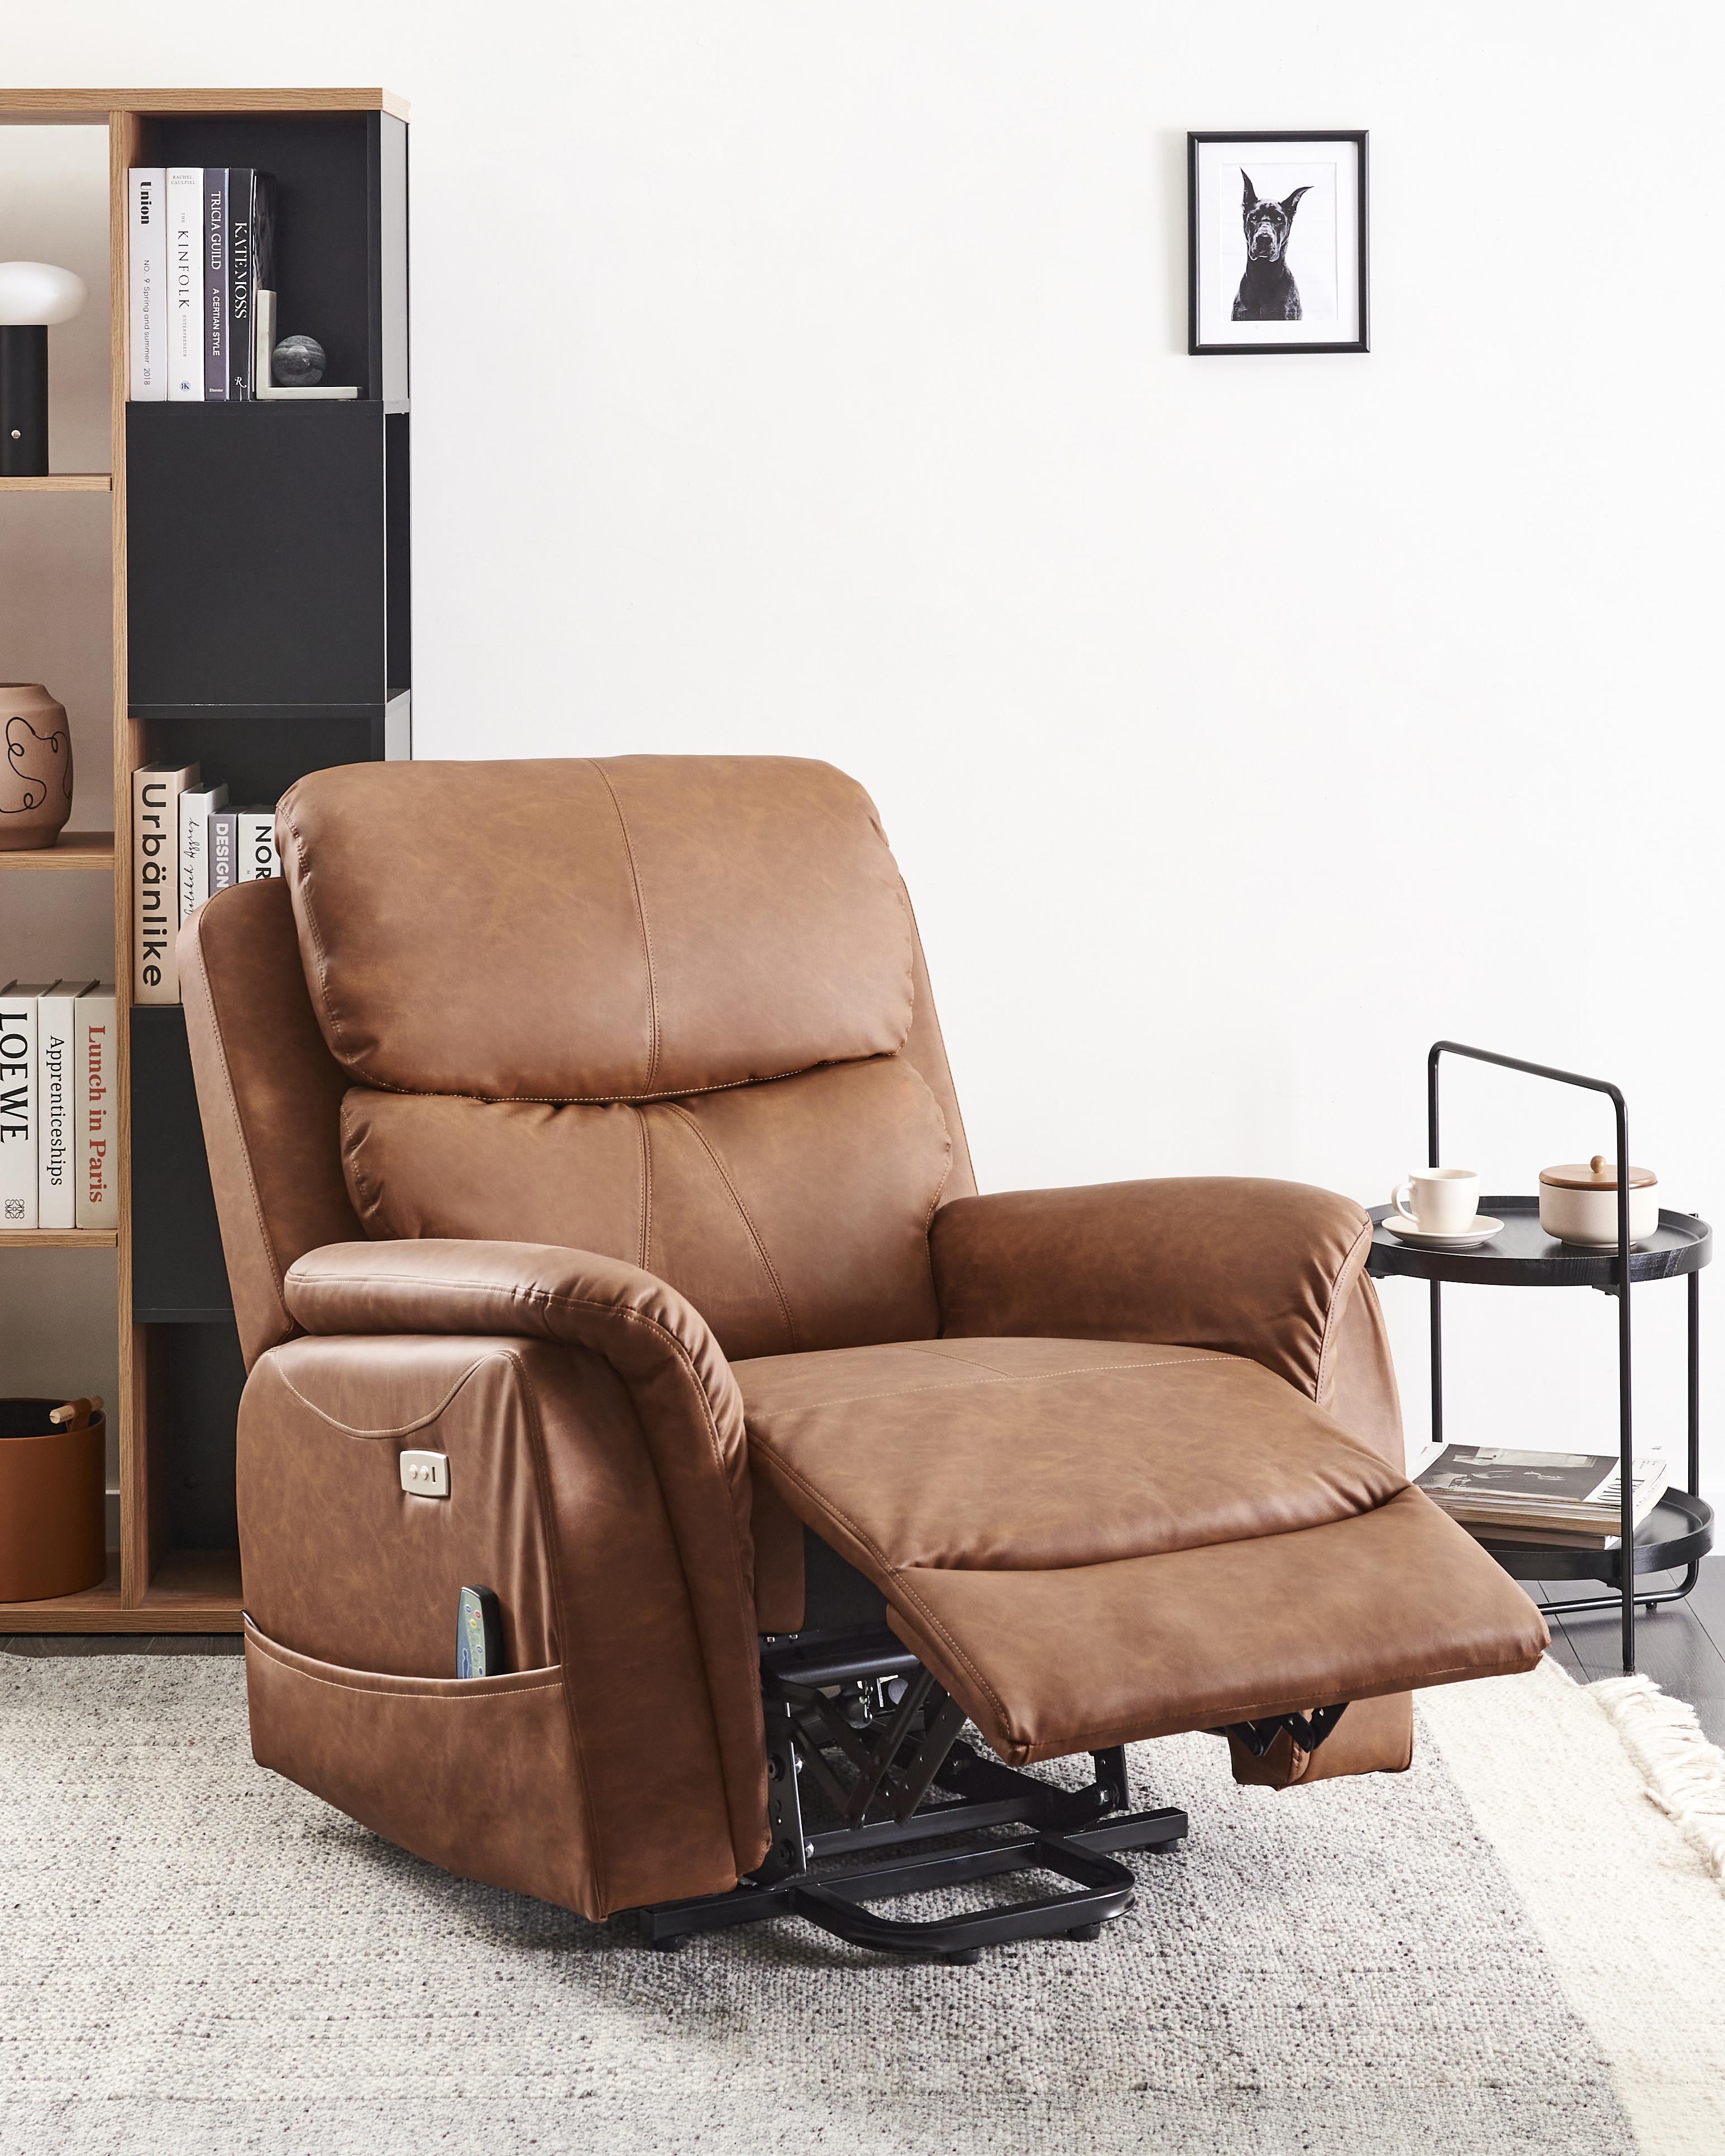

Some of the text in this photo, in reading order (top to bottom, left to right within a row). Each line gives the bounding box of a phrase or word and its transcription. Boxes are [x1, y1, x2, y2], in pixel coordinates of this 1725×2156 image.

[140, 181, 152, 224] Union
[211, 190, 221, 270] TRICIA GUILD
[178, 231, 189, 308] KINFOLK
[235, 222, 247, 319] KATE MOSS
[142, 784, 168, 987] Urbänlike
[216, 823, 230, 888] DESIGN
[255, 826, 272, 879] NOR
[0, 1012, 28, 1144] LOEWE
[46, 1035, 66, 1185] Apprenticeships
[88, 1025, 107, 1203] Lunch in Paris
